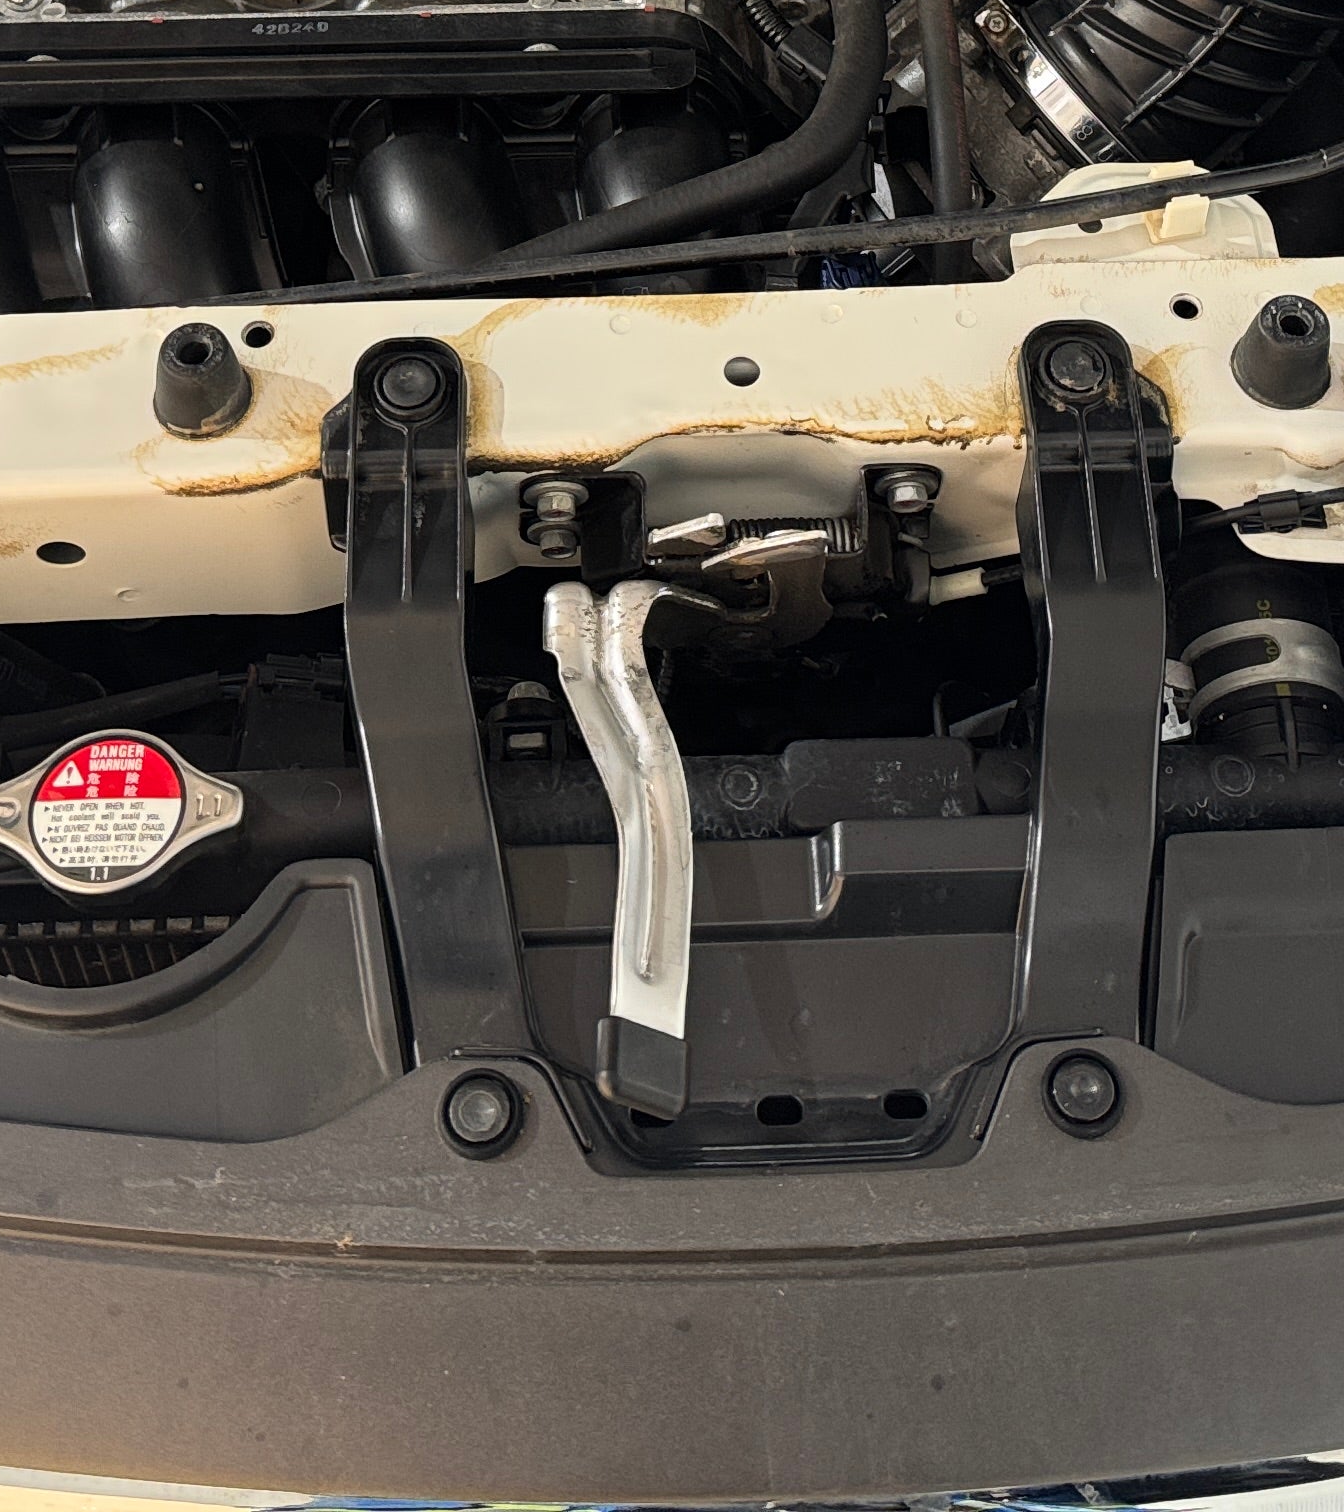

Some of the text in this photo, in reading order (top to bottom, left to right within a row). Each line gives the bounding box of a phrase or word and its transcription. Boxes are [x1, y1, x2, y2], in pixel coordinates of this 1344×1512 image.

[90, 745, 144, 758] DANGER
[89, 758, 143, 771] WARNUNG
[196, 793, 223, 819] 1.1
[90, 867, 109, 881] 1.1
